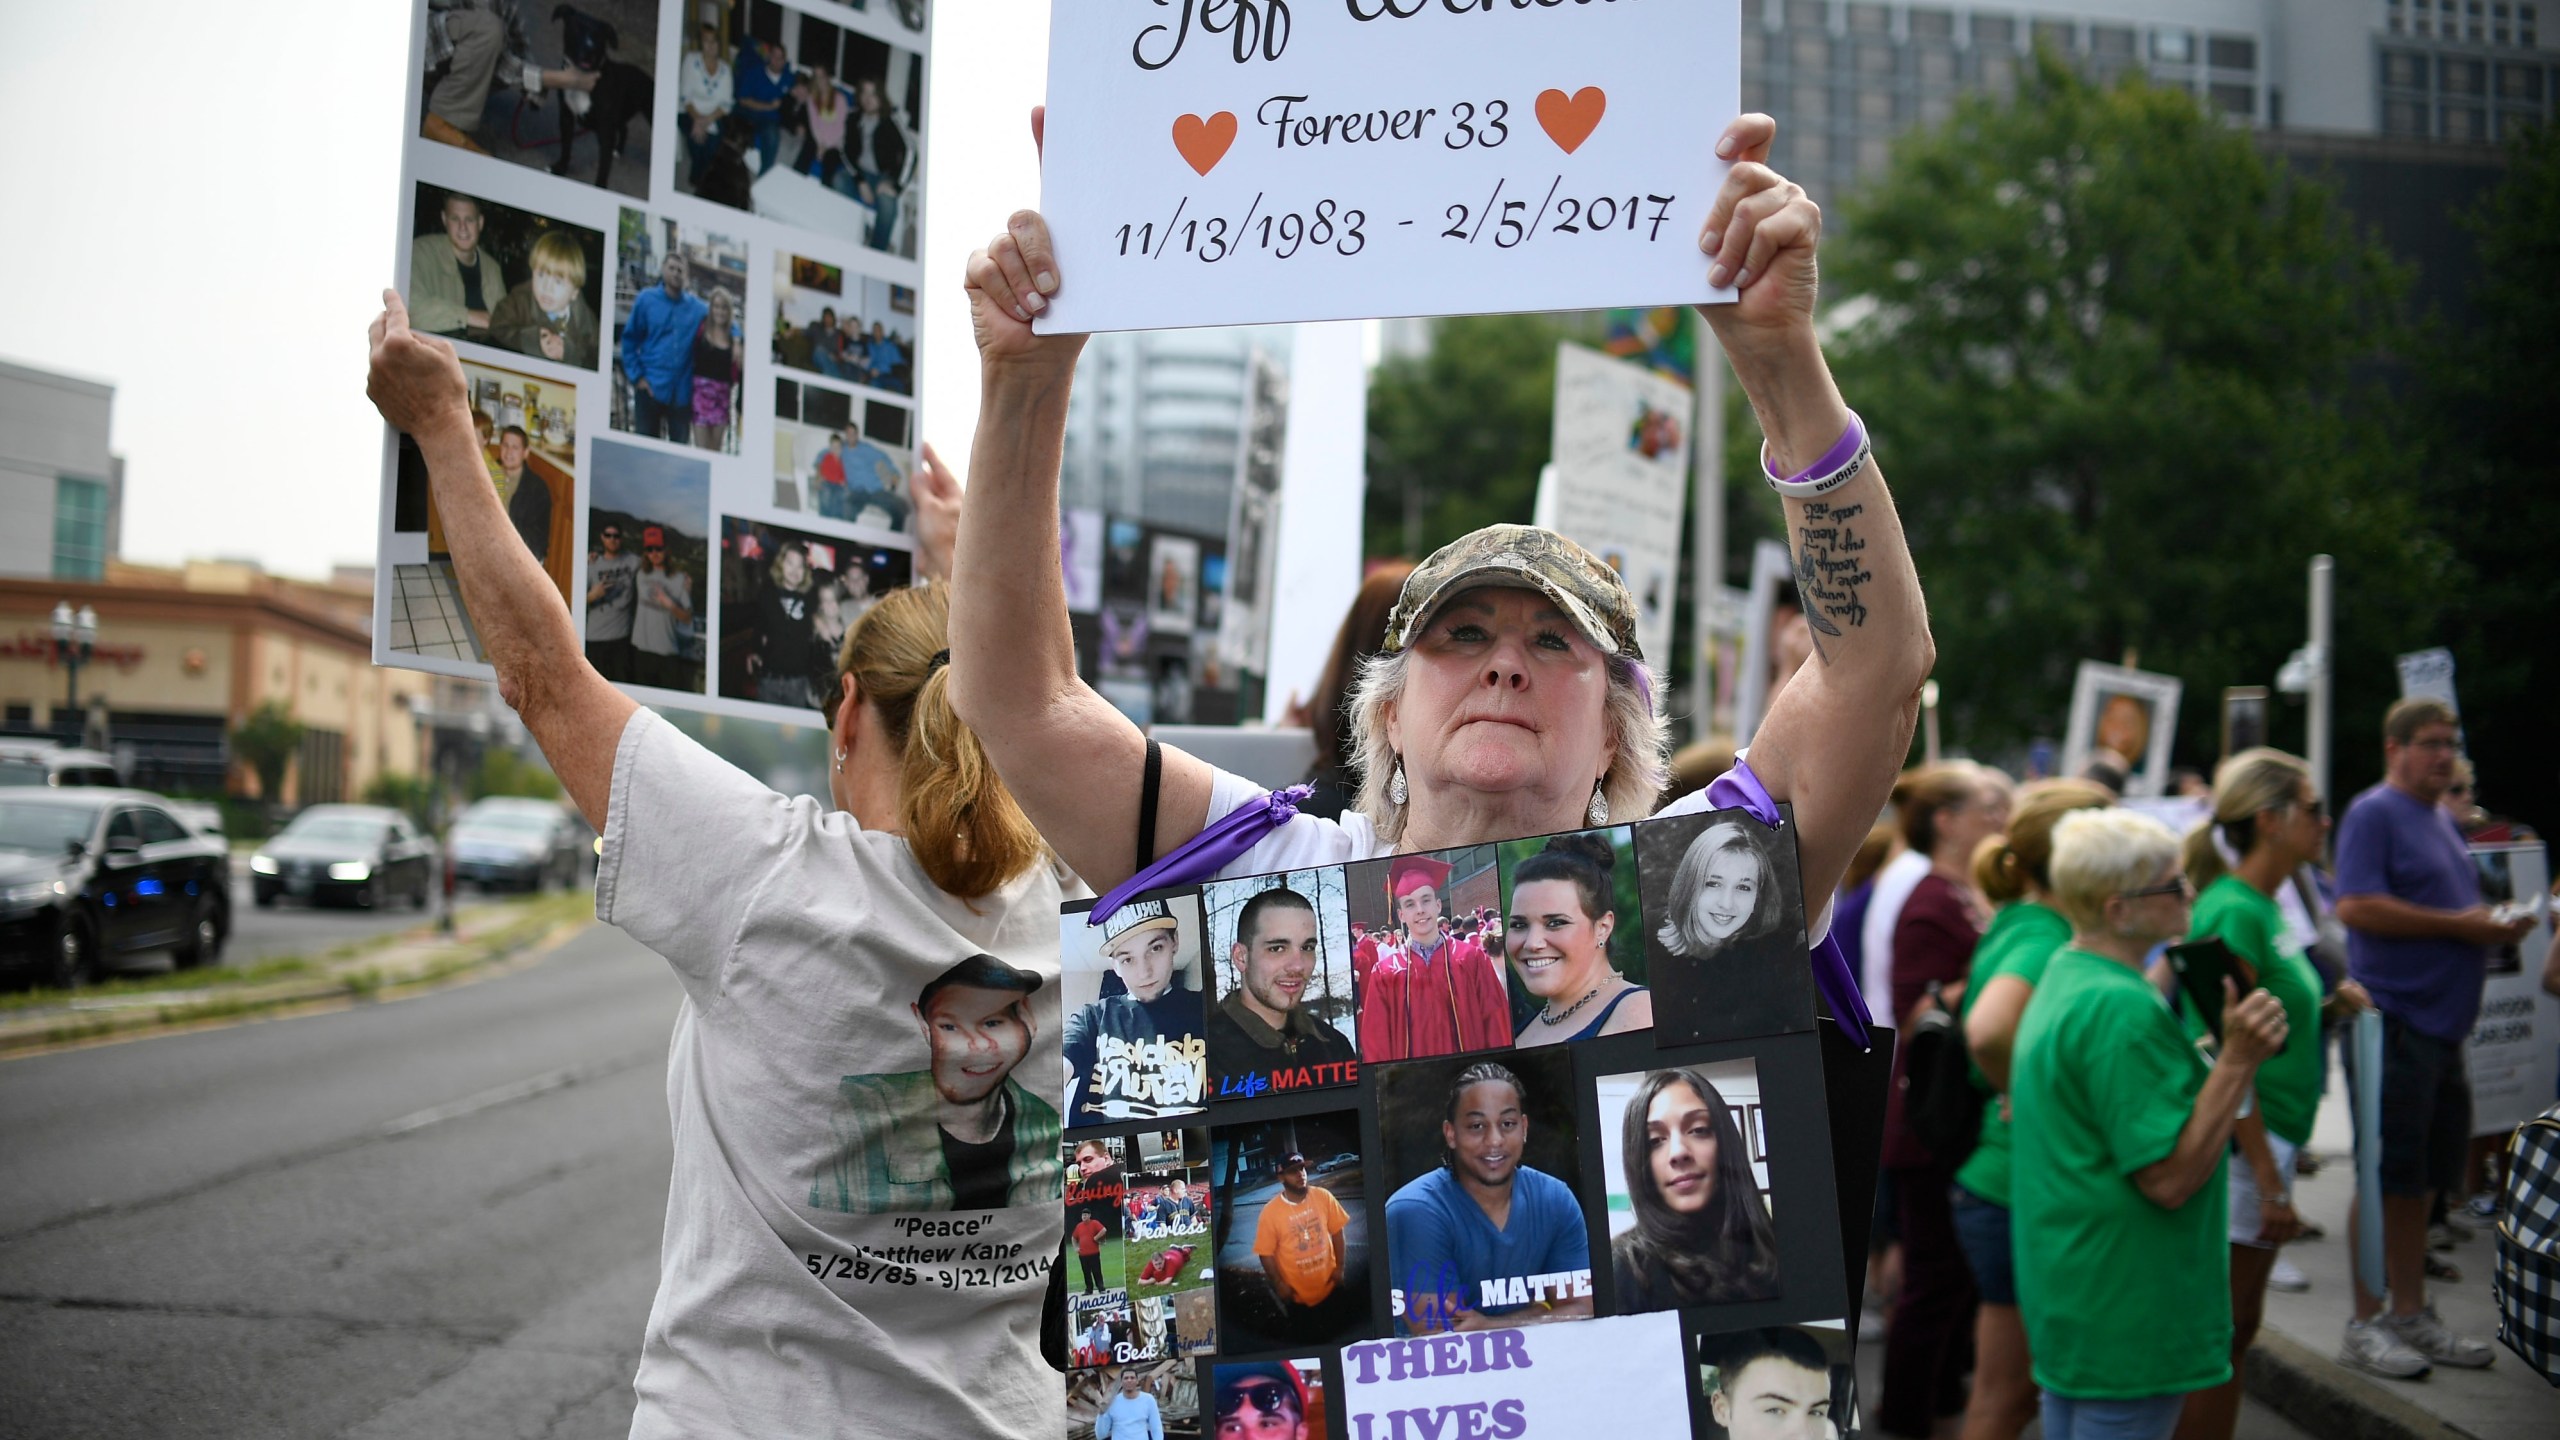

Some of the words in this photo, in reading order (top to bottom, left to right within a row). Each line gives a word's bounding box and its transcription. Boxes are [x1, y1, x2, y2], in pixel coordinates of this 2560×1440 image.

[1257, 94, 1435, 149] Forever
[1443, 99, 1510, 149] 33
[1114, 192, 1367, 262] 11/13/1983
[1441, 175, 1677, 248] 2/5/2017
[1815, 461, 1859, 492] Stigma
[1799, 527, 1839, 552] heart
[1815, 548, 1859, 584] ready
[1838, 571, 1871, 588] were
[1824, 590, 1867, 627] Your
[1271, 1060, 1358, 1090] MATTE
[1065, 1179, 1124, 1208] Loving
[893, 1214, 994, 1238] "Peace"
[1132, 1213, 1208, 1243] Fearless
[961, 1242, 1024, 1261] Kane
[805, 1253, 918, 1287] 5/28/85
[938, 1255, 1053, 1290] 9/22/2014
[1067, 1289, 1129, 1314] Amazing
[1480, 1268, 1593, 1308] MATTE
[1114, 1337, 1160, 1364] Best
[1347, 1328, 1533, 1384] THEIR
[1352, 1399, 1527, 1440] LIVES
